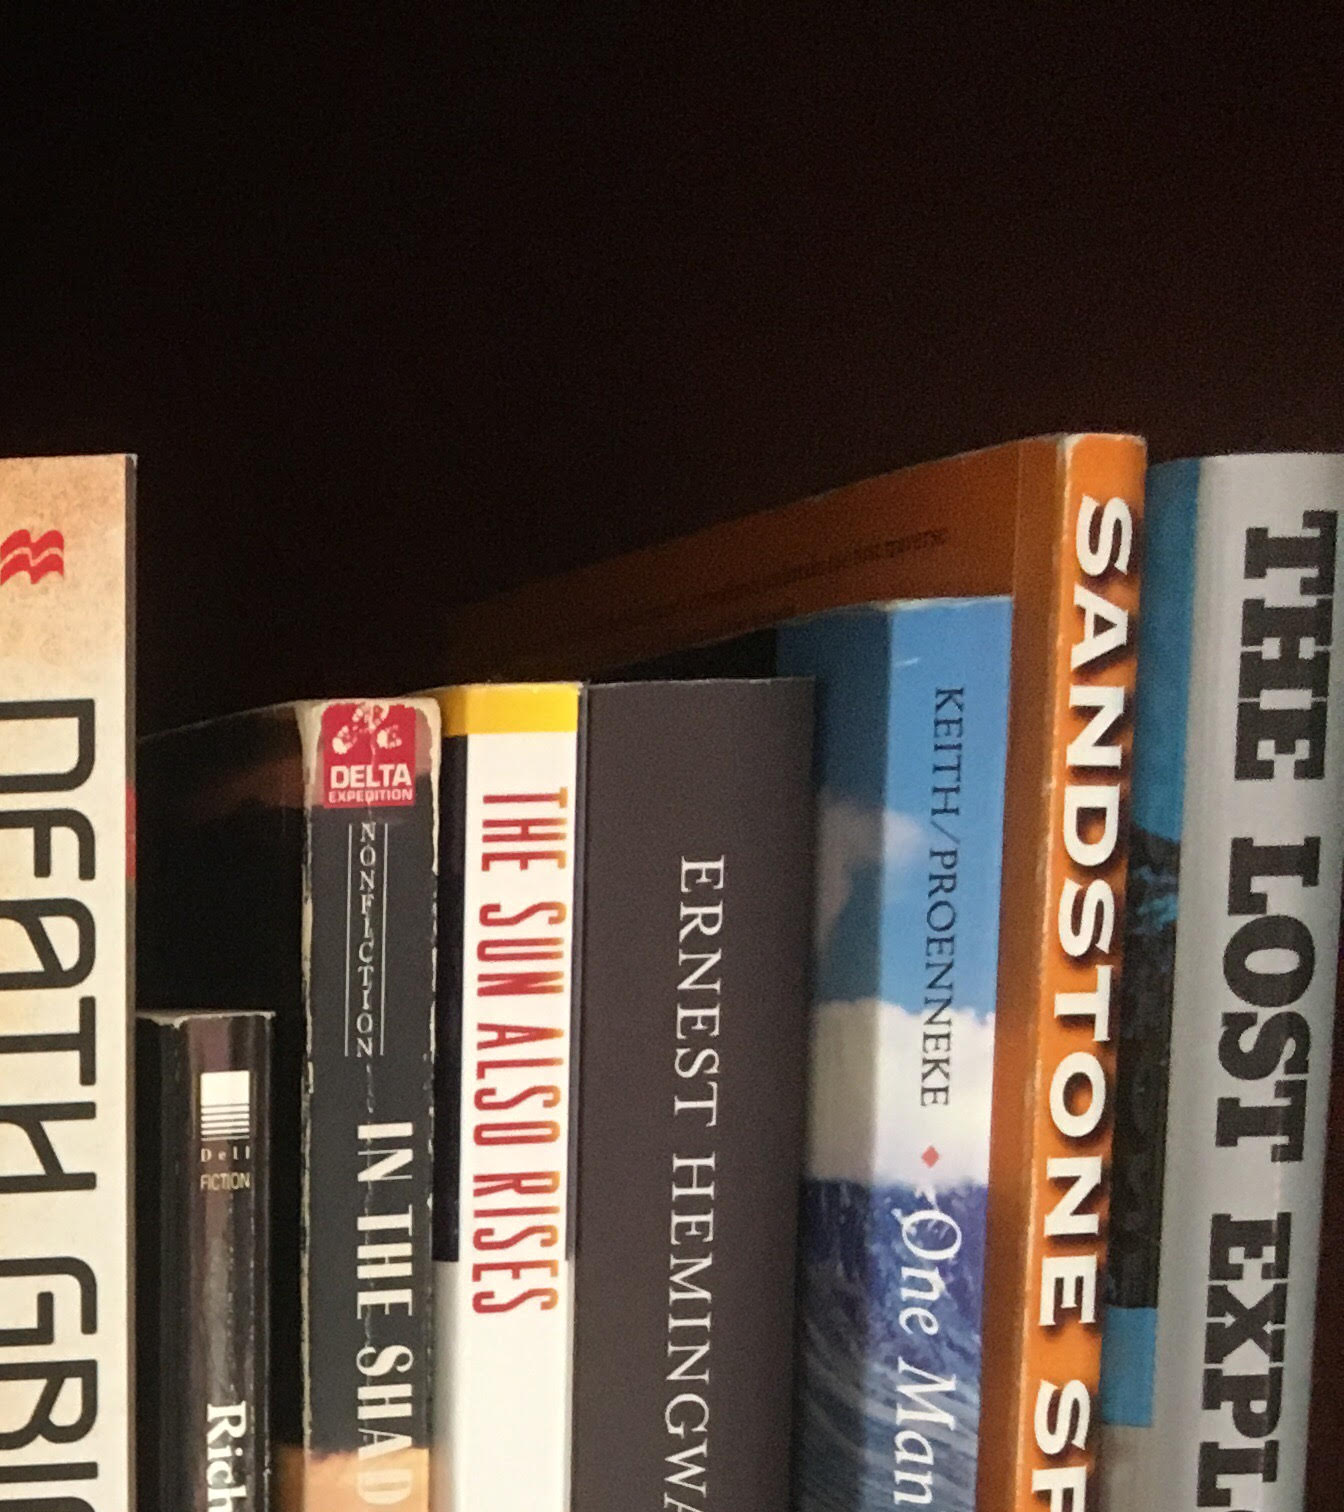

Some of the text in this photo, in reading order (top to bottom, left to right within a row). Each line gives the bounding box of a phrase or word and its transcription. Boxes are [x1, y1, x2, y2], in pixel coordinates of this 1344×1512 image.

[1234, 509, 1339, 781] THE
[328, 788, 412, 804] EXPEDITION
[331, 764, 412, 787] DELTA
[357, 822, 376, 1058] NONFICTION
[673, 854, 725, 1129] ERNEST
[1038, 493, 1133, 1327] SANDSTONE
[1216, 837, 1321, 1163] LOST
[356, 1121, 412, 1182] IN
[472, 787, 568, 1314] THE SUN ALSO RISES
[201, 1172, 250, 1190] FICTION
[356, 1204, 412, 1319] THE
